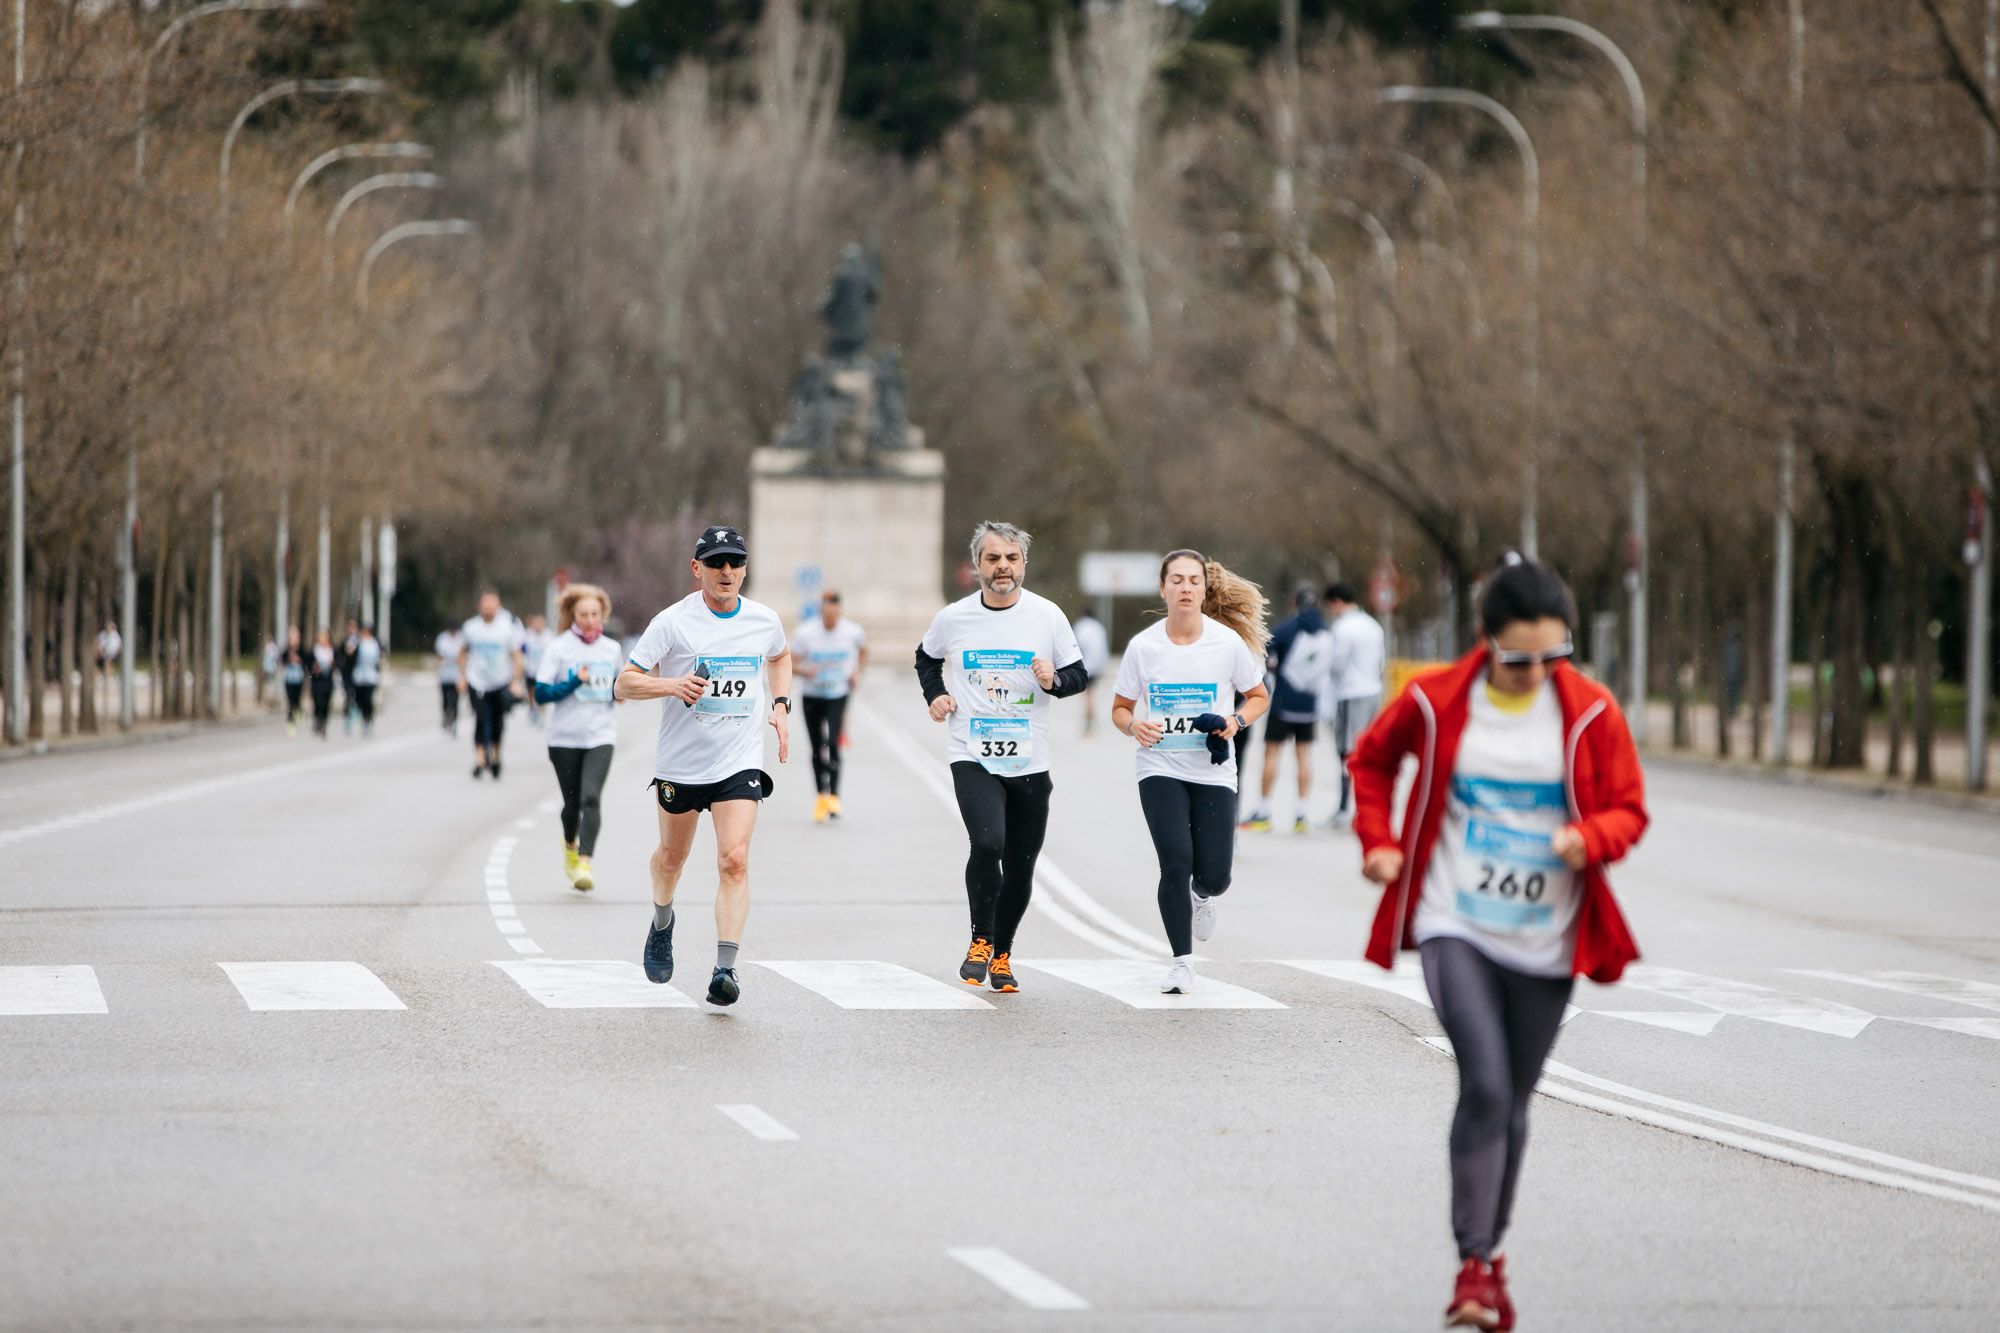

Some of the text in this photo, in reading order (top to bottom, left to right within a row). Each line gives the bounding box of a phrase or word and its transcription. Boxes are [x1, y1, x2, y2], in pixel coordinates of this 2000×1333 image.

[711, 680, 746, 697] 149
[1164, 718, 1195, 733] 147
[981, 740, 1018, 757] 332
[1478, 862, 1546, 902] 260
